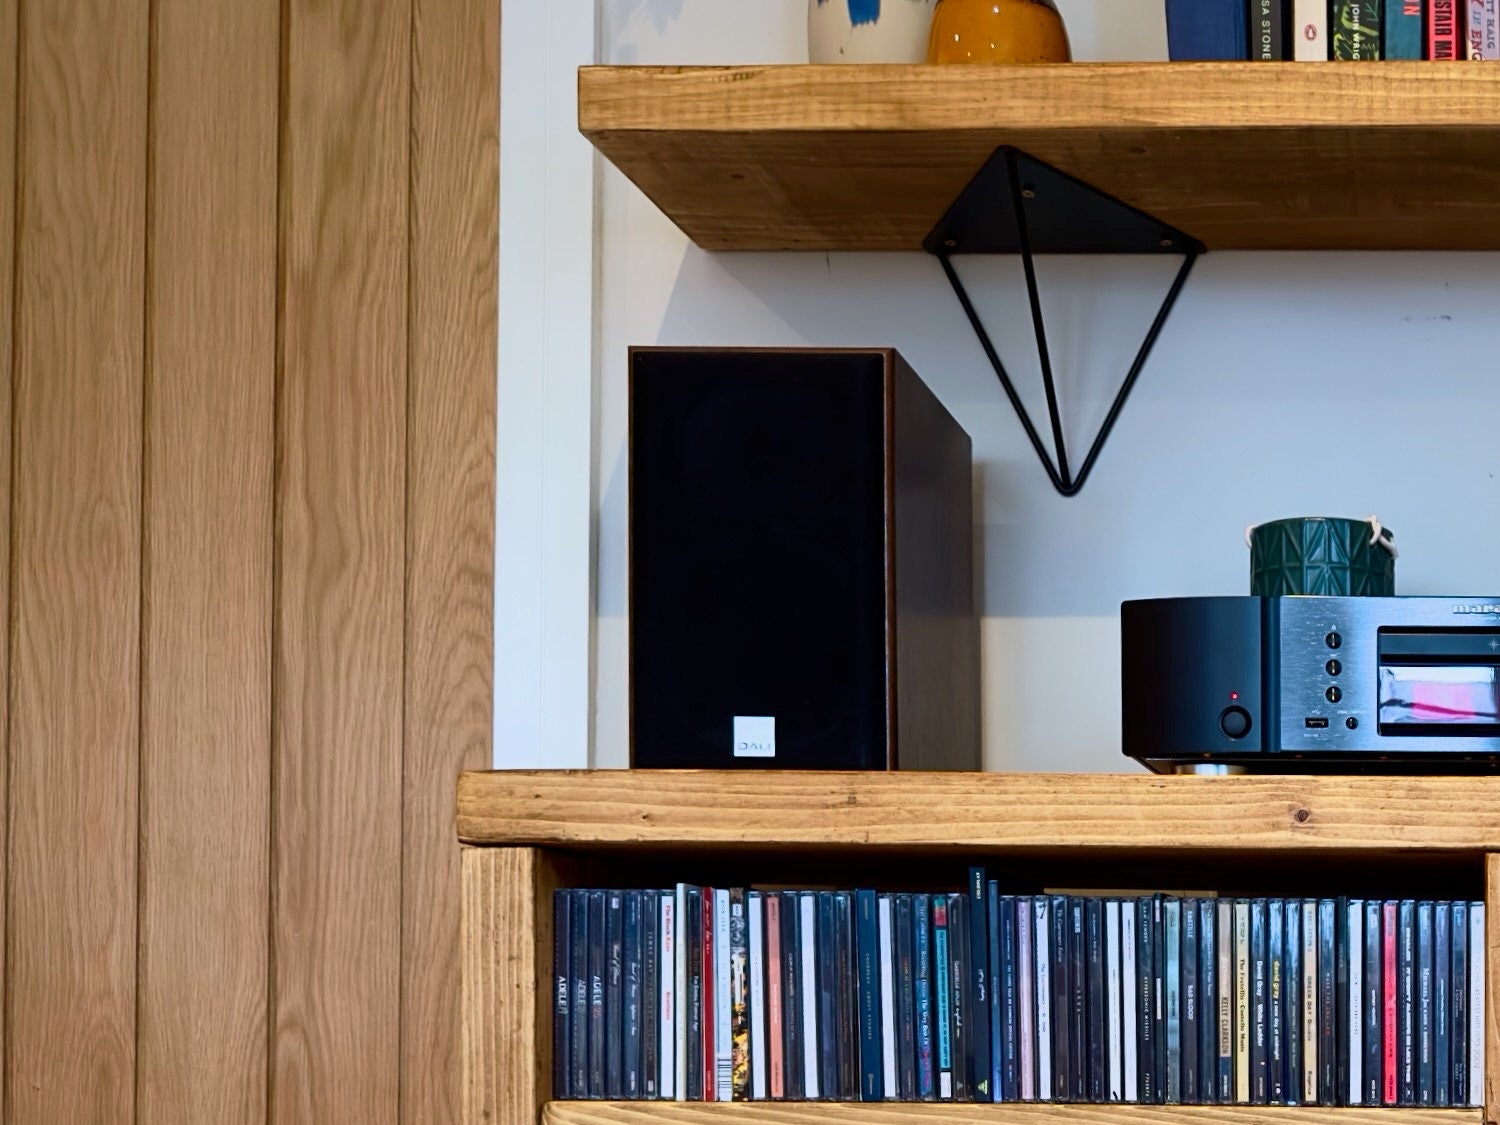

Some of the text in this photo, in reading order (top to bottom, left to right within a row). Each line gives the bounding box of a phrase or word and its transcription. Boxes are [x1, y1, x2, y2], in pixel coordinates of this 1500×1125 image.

[1350, 4, 1360, 31] JOHN
[1262, 20, 1271, 60] STONE
[559, 976, 567, 1007] ADELE
[593, 976, 601, 1006] ADELE
[1272, 983, 1280, 998] gray
[1221, 997, 1229, 1054] KELLY CLARKSON
